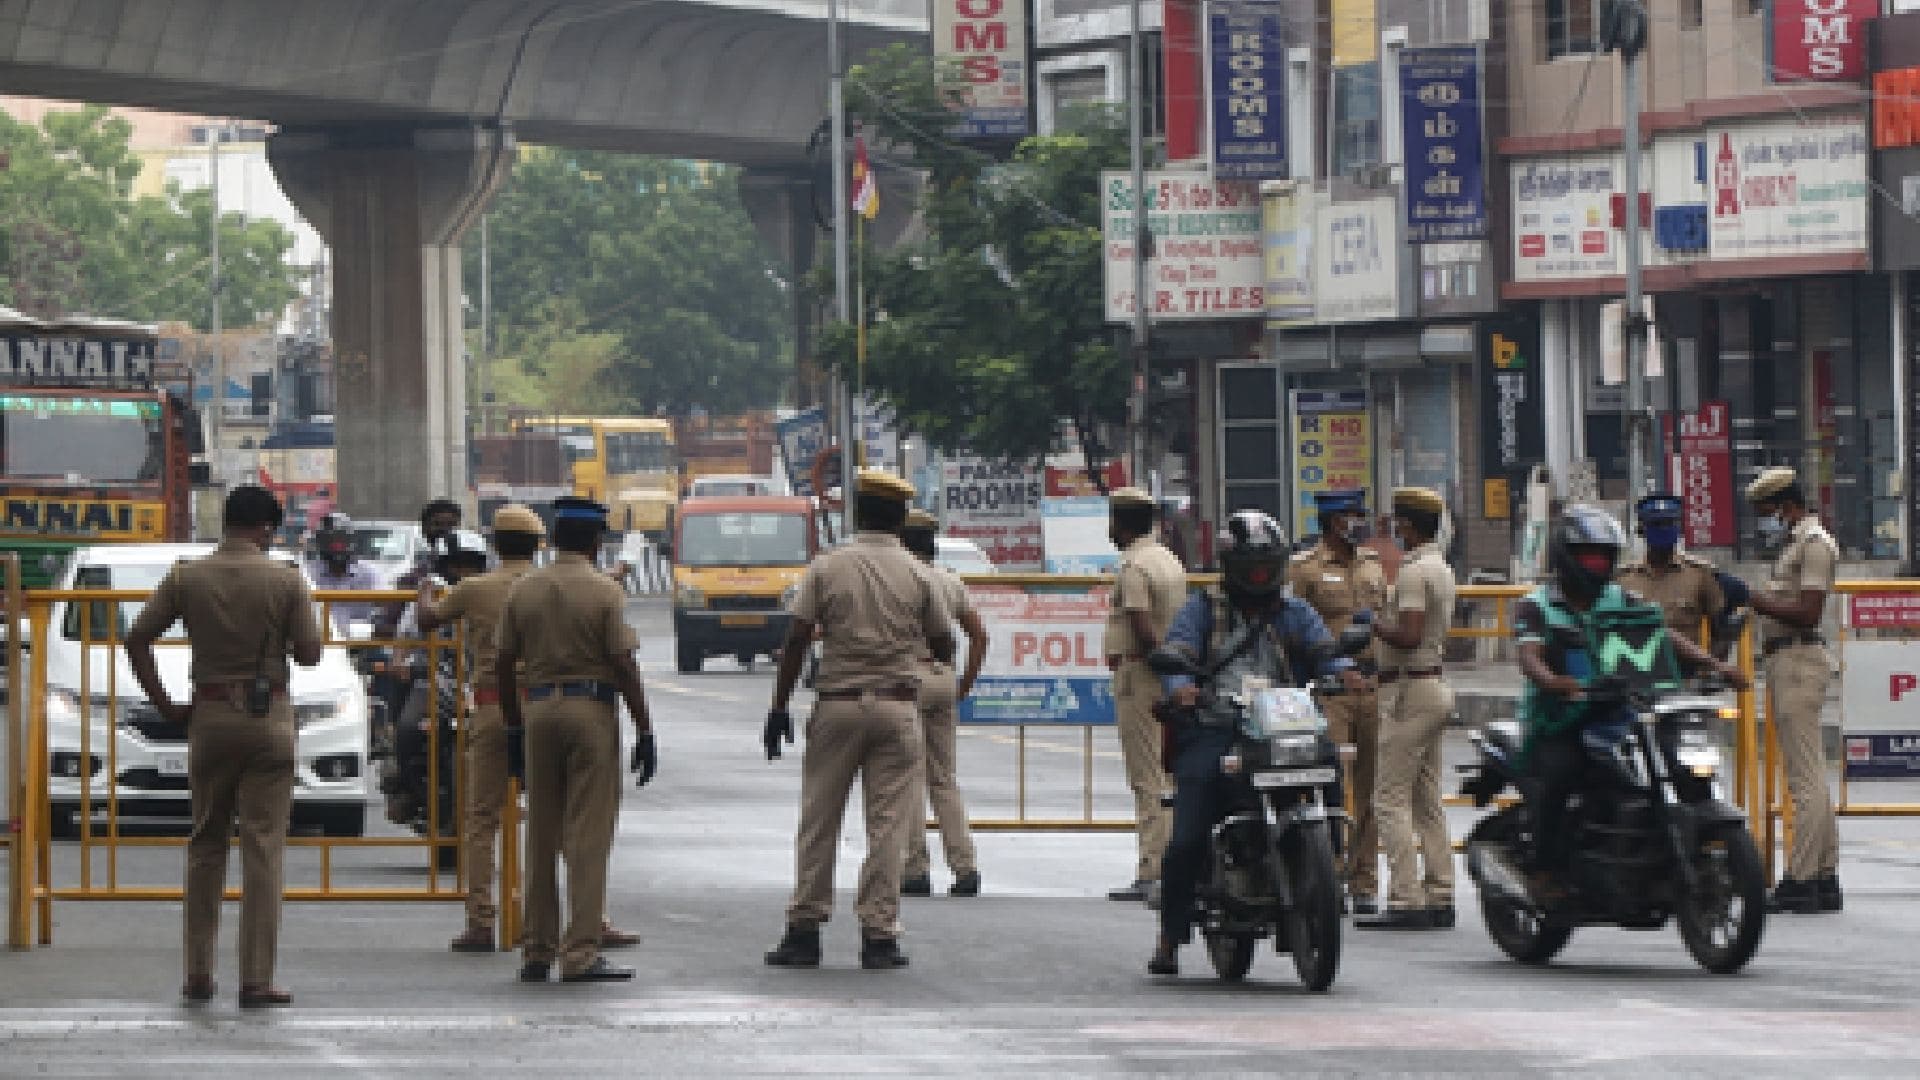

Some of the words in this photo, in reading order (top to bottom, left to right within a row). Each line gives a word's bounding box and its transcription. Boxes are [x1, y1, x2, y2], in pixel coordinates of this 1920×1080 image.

[1228, 31, 1268, 137] ROOMS
[1189, 183, 1212, 209] to
[1184, 286, 1264, 313] TILES
[945, 482, 1041, 511] ROOMS
[1686, 453, 1715, 546] ROOMS
[1012, 631, 1106, 668] POL
